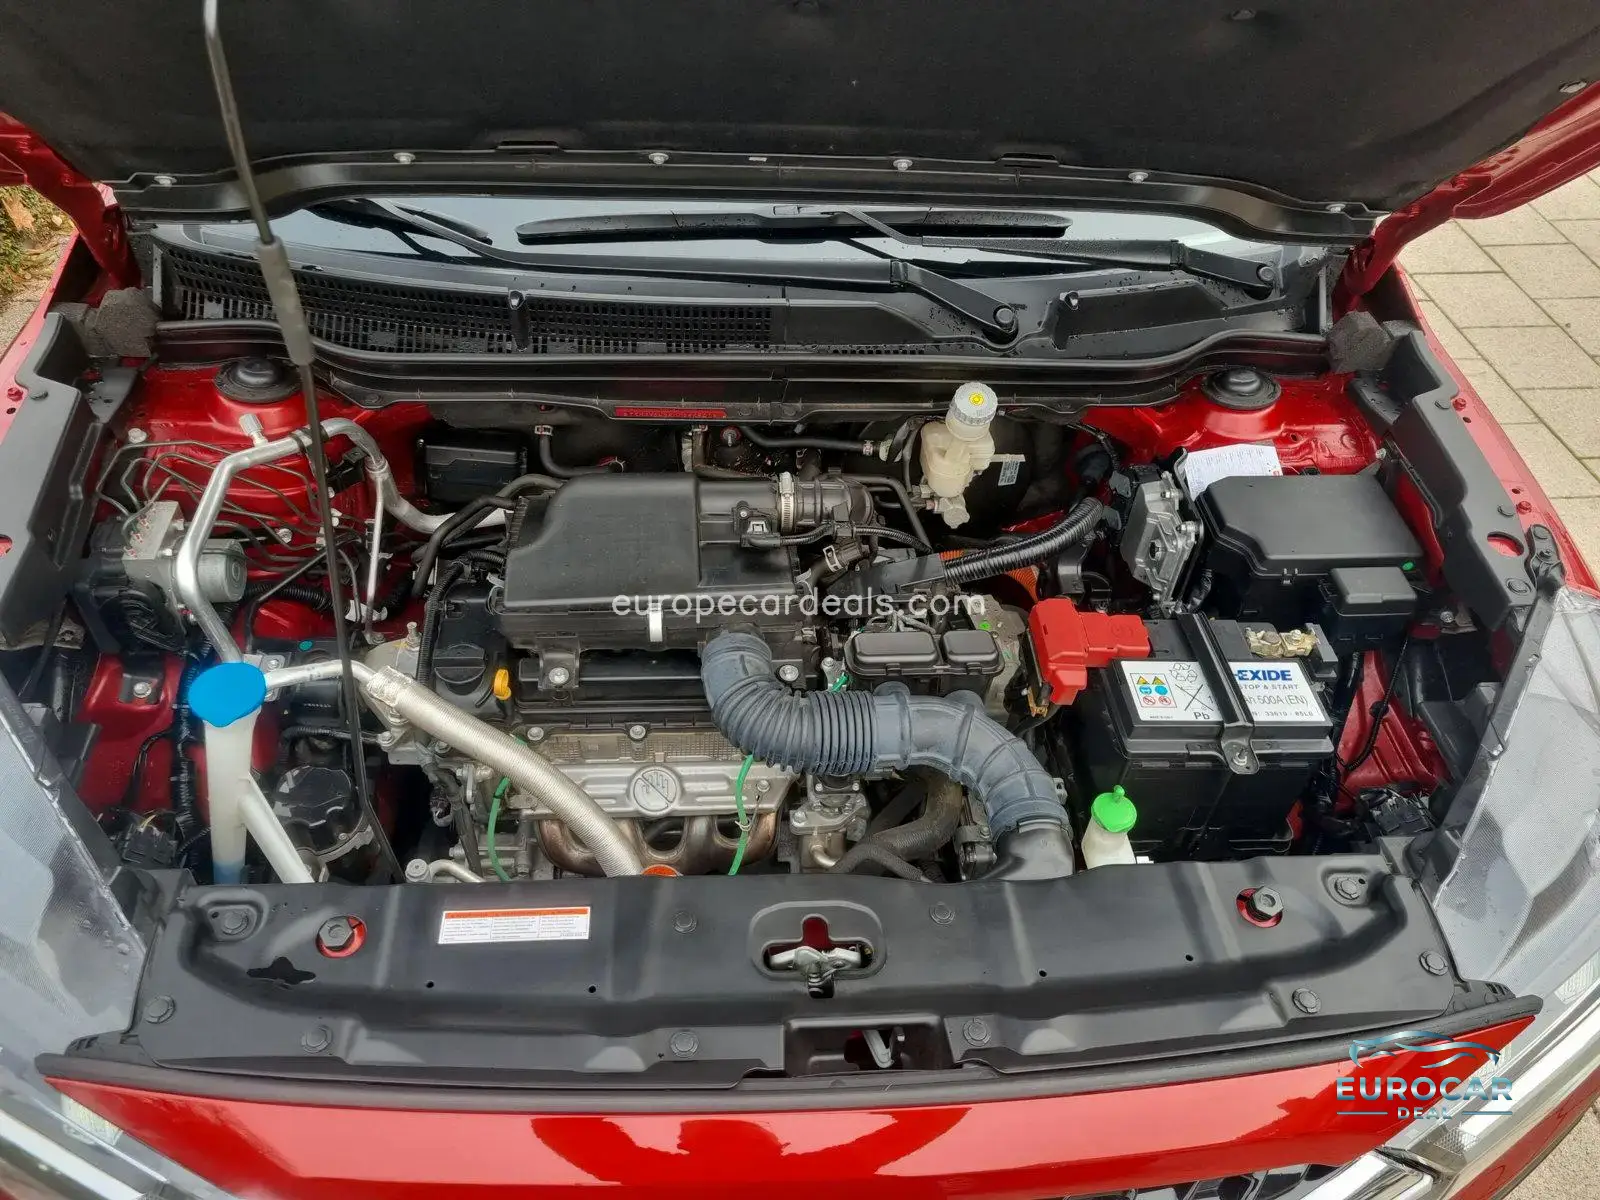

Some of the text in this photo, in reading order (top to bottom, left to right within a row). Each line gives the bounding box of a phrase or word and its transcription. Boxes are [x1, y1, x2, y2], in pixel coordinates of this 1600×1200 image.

[1236, 669, 1292, 681] EXIDE
[1285, 695, 1309, 708] (EN)
[1194, 711, 1211, 720] Pb
